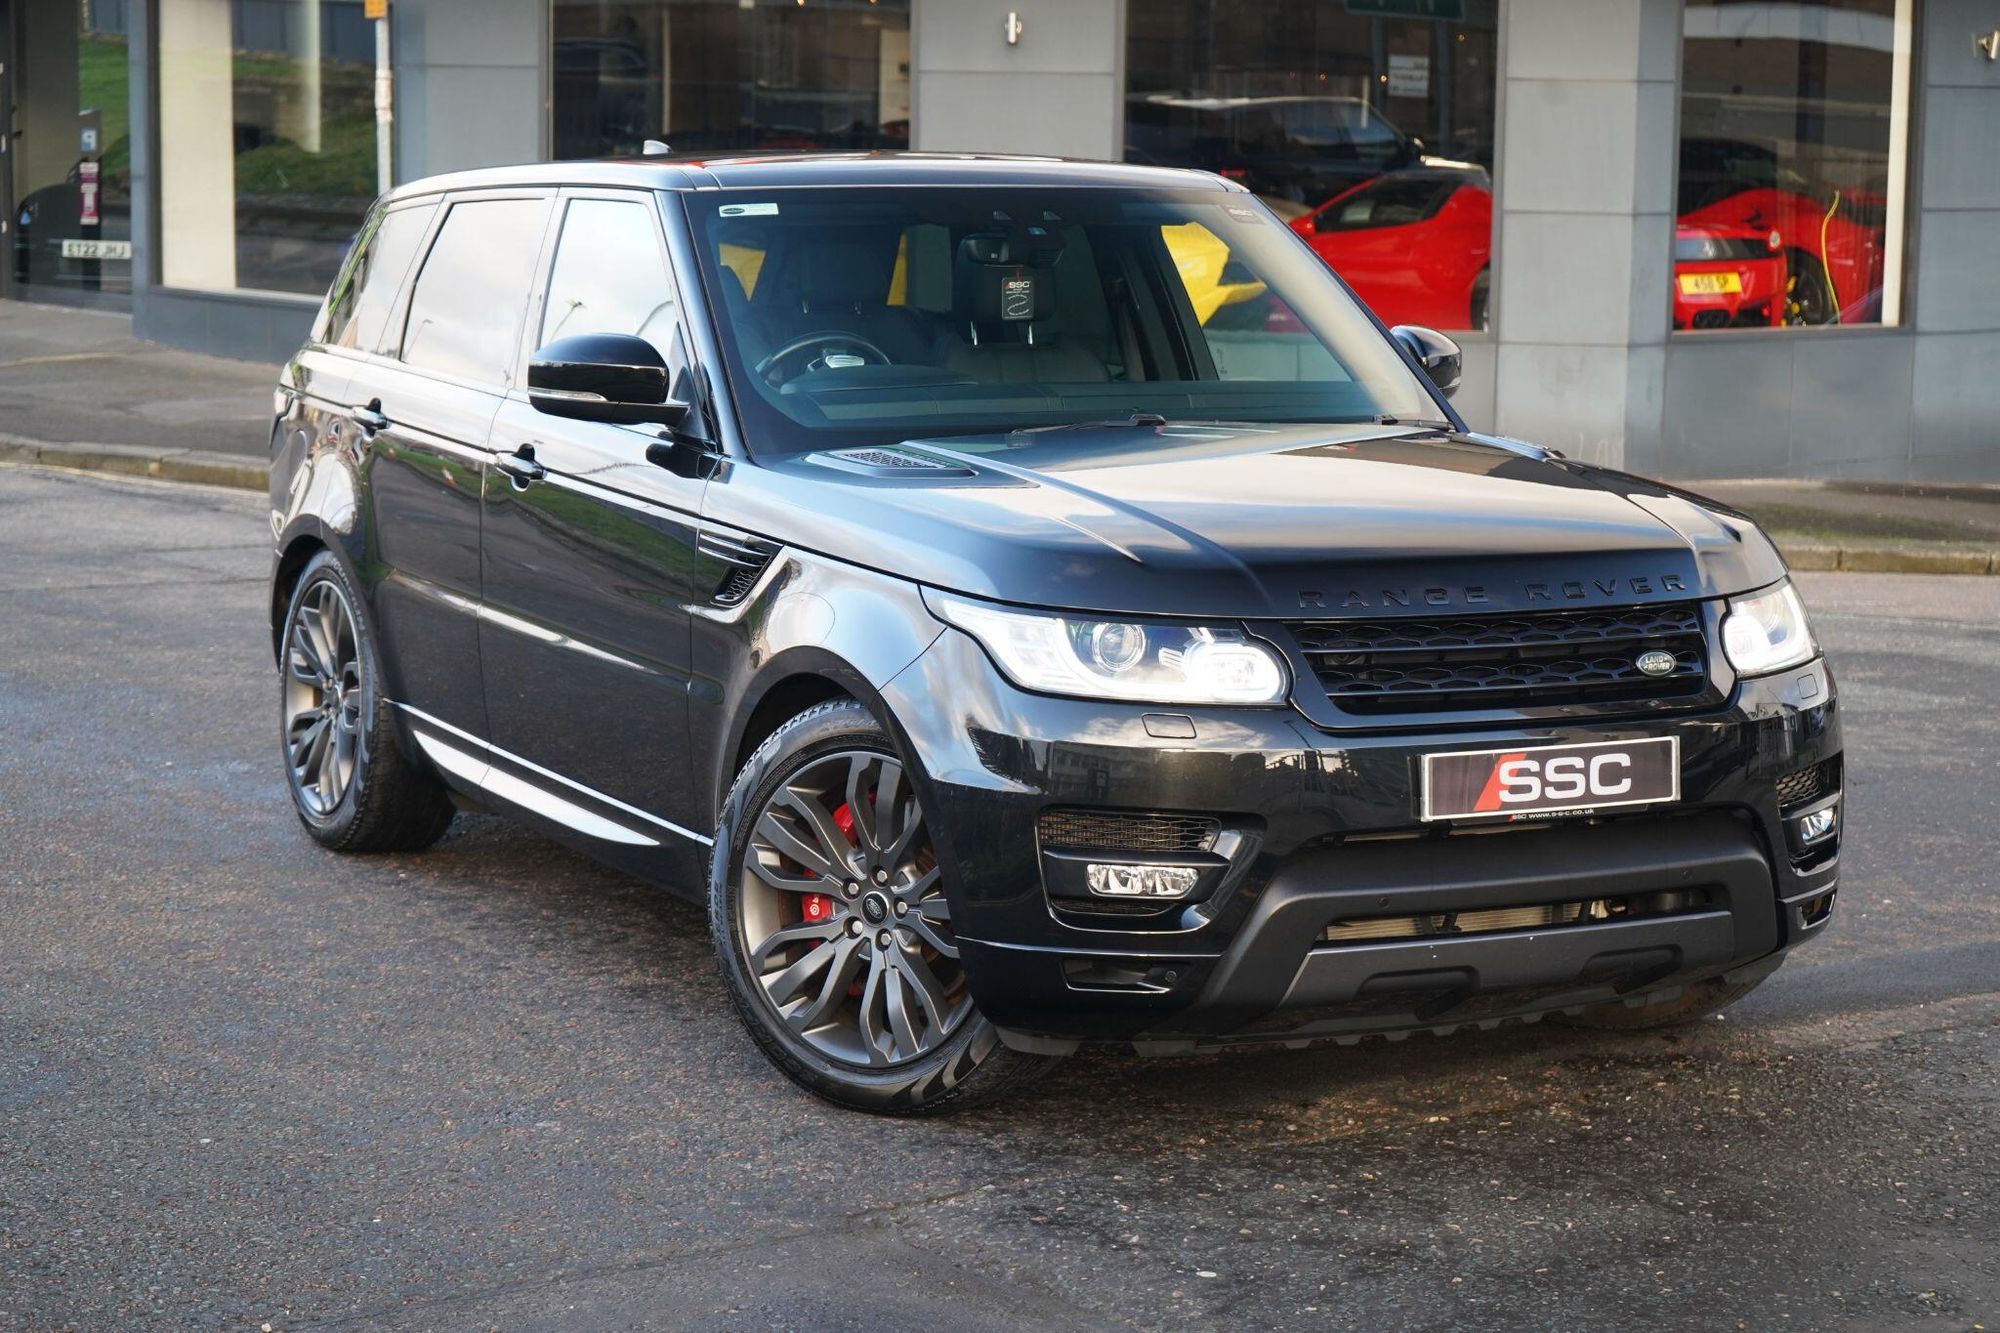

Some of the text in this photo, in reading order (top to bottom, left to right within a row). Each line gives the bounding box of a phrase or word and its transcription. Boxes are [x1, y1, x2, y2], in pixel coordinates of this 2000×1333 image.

[1008, 281, 1030, 289] SSC
[1298, 574, 1686, 608] RANGE ROVER
[1645, 655, 1664, 664] LAND
[1648, 662, 1670, 671] ROVER
[1499, 753, 1632, 803] SSC
